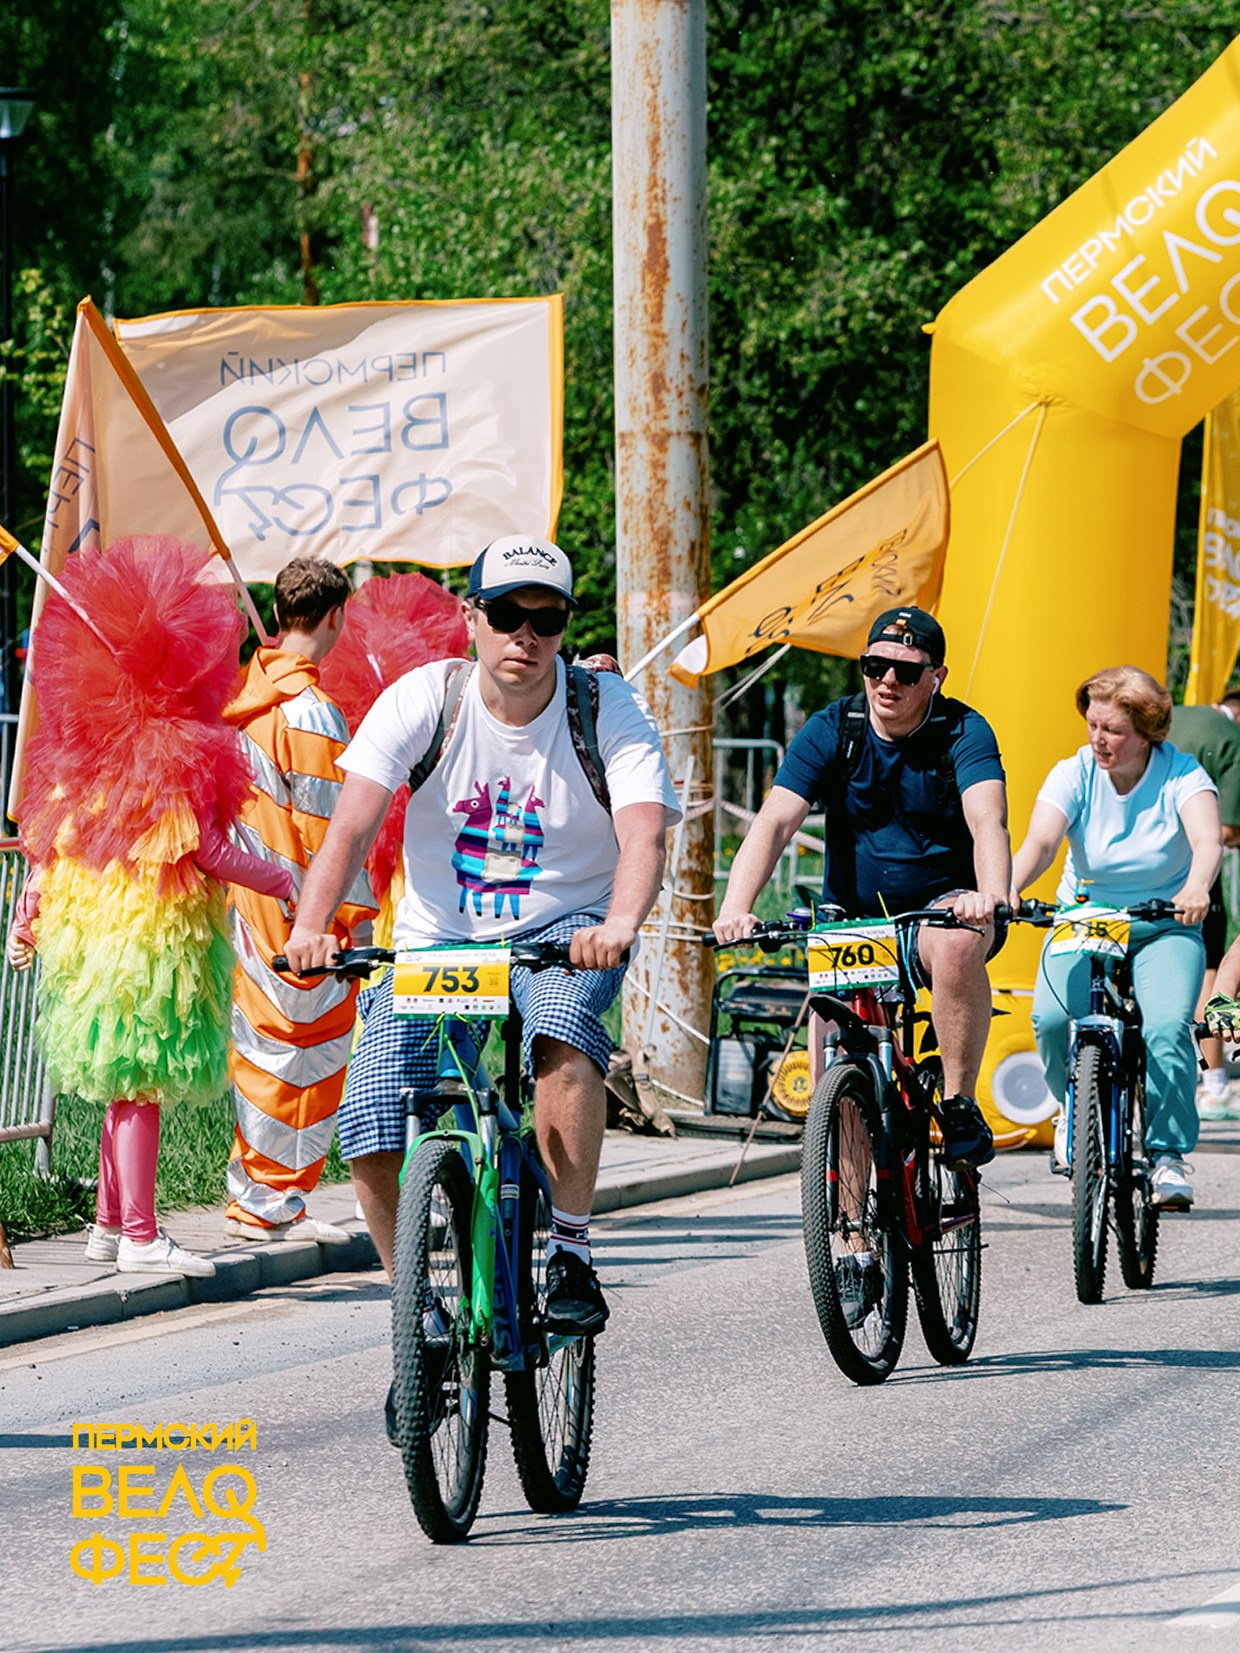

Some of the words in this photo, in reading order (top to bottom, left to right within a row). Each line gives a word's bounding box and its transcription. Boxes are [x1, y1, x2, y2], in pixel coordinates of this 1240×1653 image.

[1040, 136, 1218, 305] ПЕРМСКИЙ
[502, 546, 558, 568] BALANCE
[830, 944, 875, 967] 760
[422, 966, 480, 993] 753
